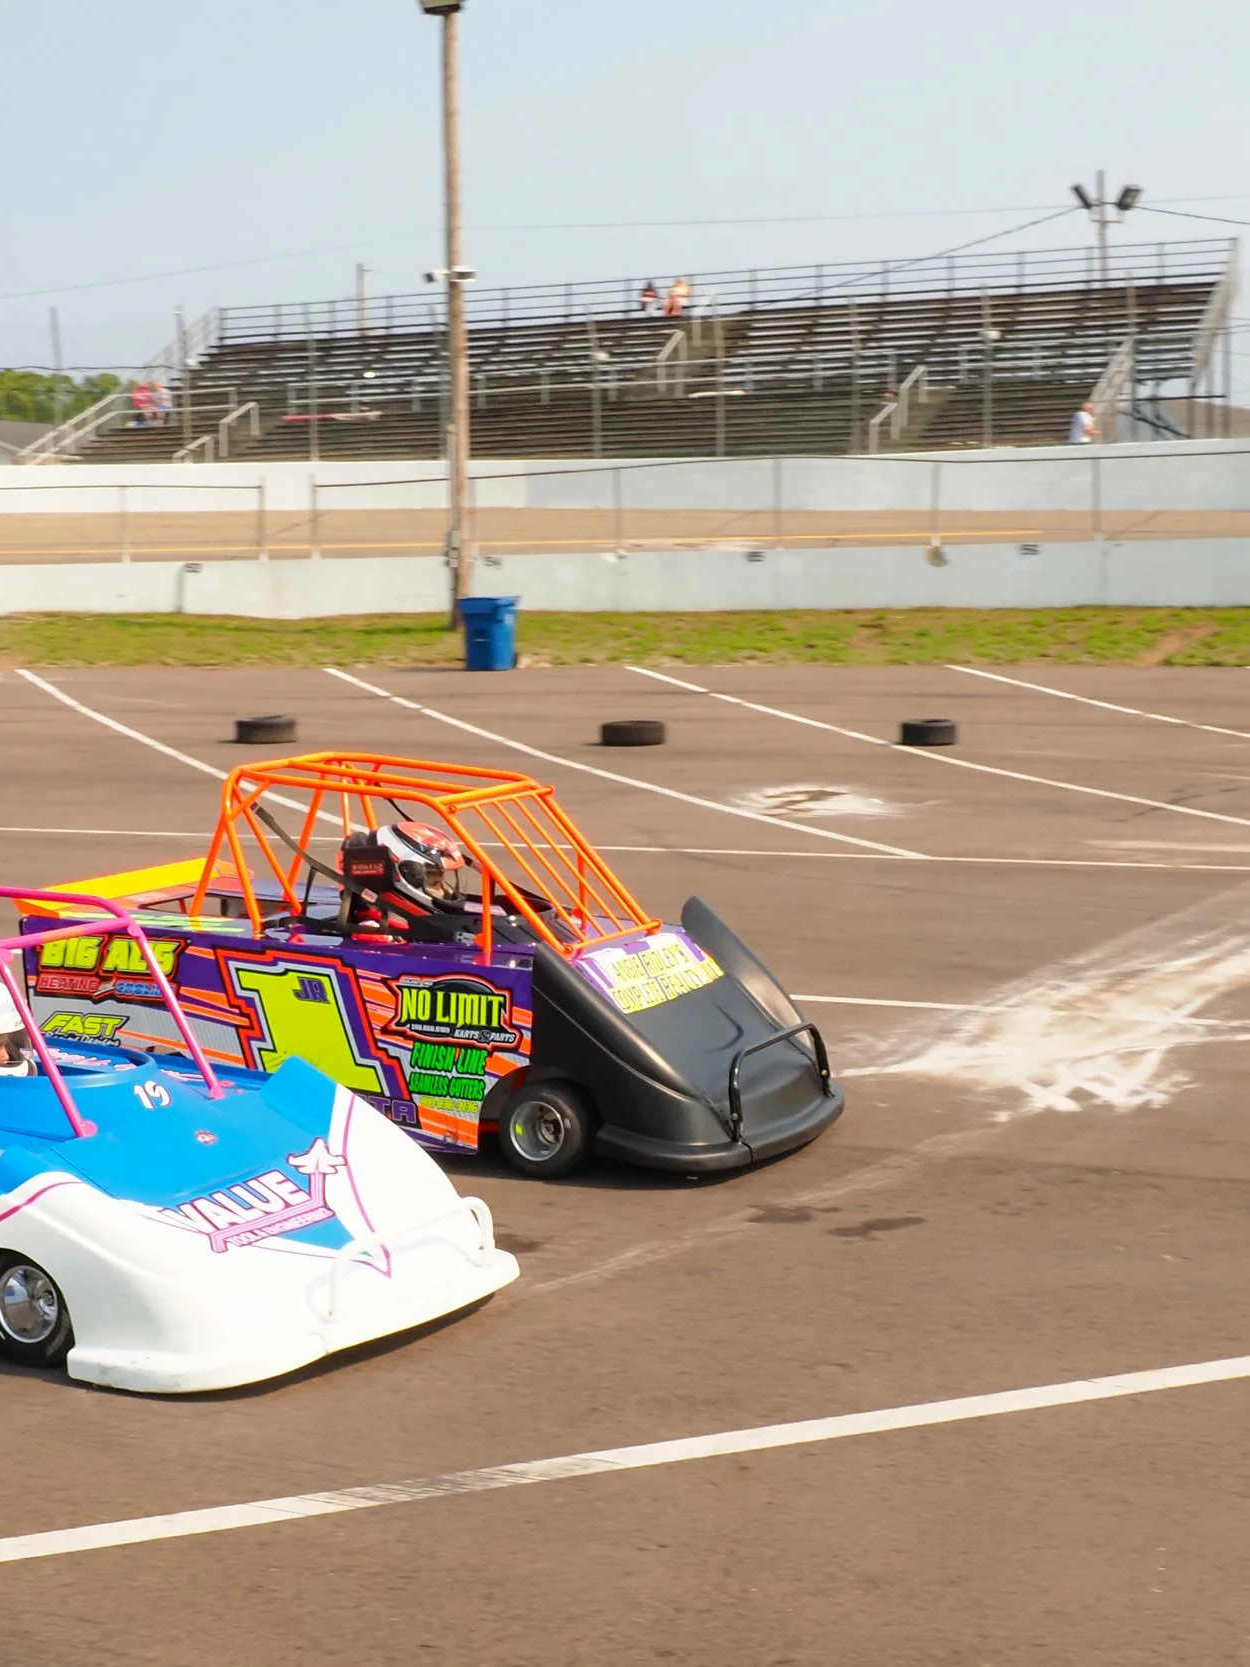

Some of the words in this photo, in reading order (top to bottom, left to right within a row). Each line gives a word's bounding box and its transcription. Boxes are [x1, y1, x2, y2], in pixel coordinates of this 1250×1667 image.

[41, 937, 103, 969] BIG
[611, 955, 648, 981] ANGIE
[39, 977, 100, 993] HEATING
[293, 976, 330, 1004] JR
[400, 988, 431, 1022] NO
[435, 990, 505, 1027] LIMIT
[42, 1013, 123, 1037] FAST
[233, 966, 386, 1094] 1
[453, 1029, 480, 1040] KARTS
[489, 1031, 516, 1043] PARTS
[412, 1041, 456, 1072] FINISH
[456, 1047, 489, 1075] LINE
[133, 1080, 172, 1110] 19
[410, 1072, 450, 1097] SEAMLESS
[450, 1077, 485, 1101] GUTTERS
[159, 1170, 312, 1234] VALUE
